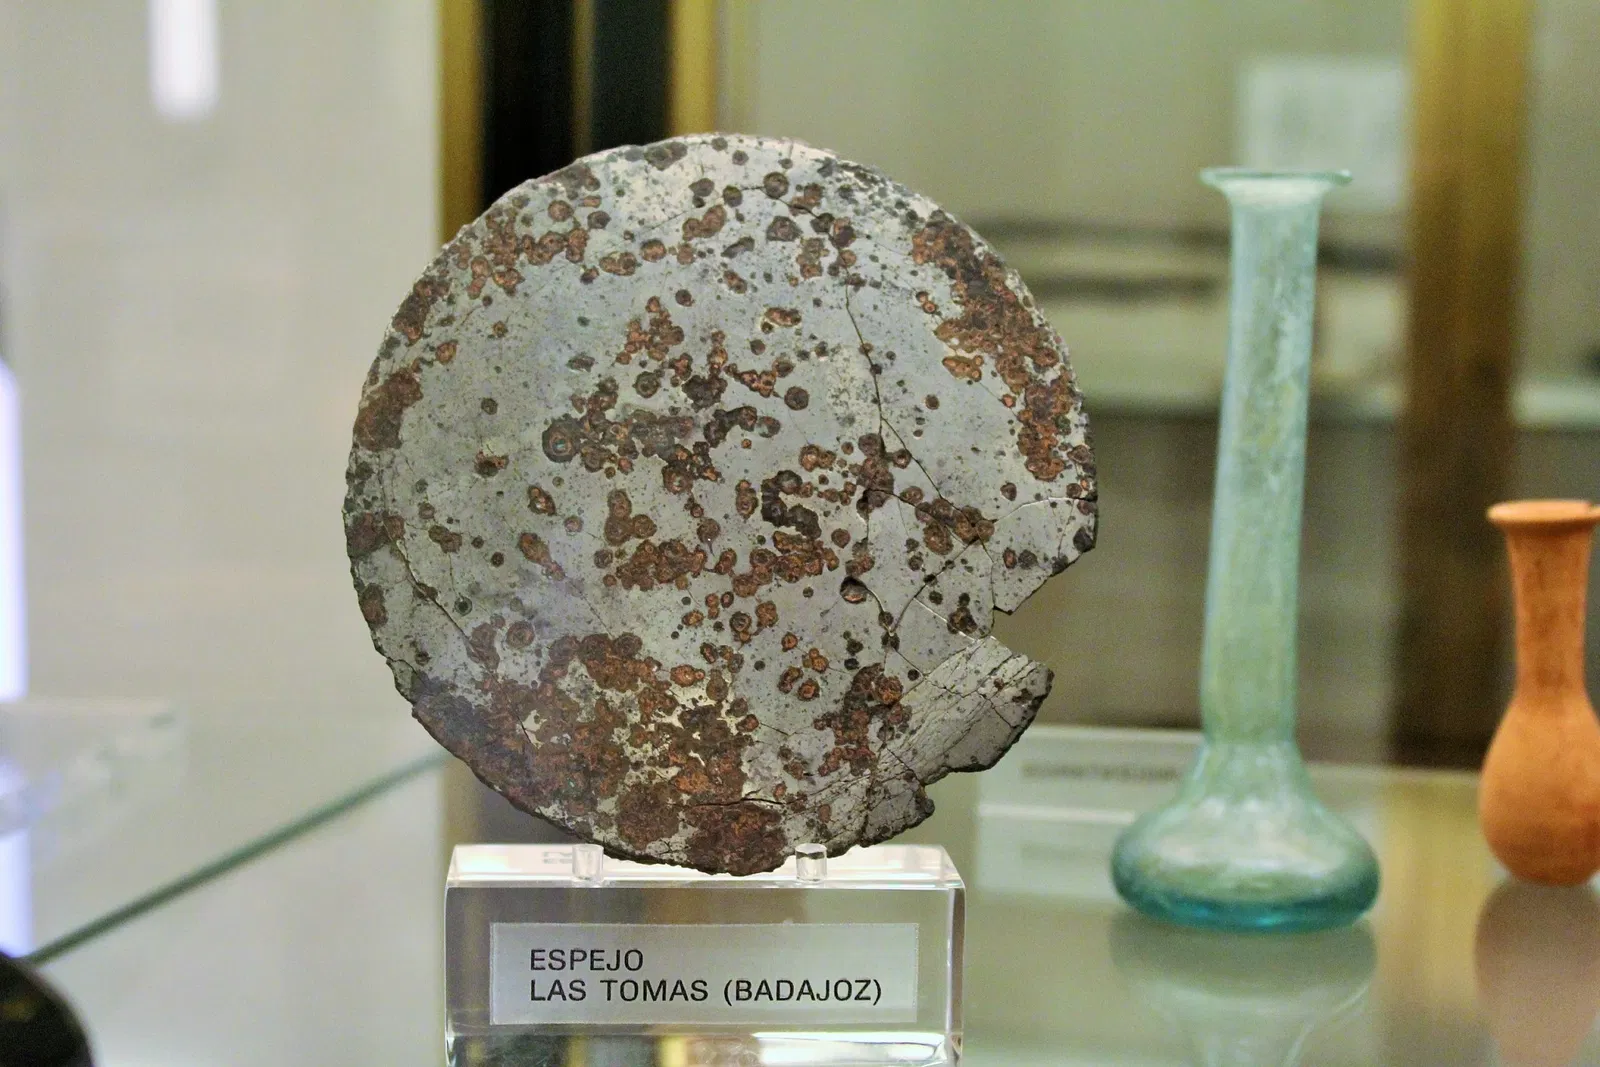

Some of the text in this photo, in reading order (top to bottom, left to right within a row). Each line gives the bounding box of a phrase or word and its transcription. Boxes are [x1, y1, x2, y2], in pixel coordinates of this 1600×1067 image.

[530, 947, 644, 971] ESPEJO
[530, 978, 882, 1006] LAS TOMAS (BADAJOZ)
